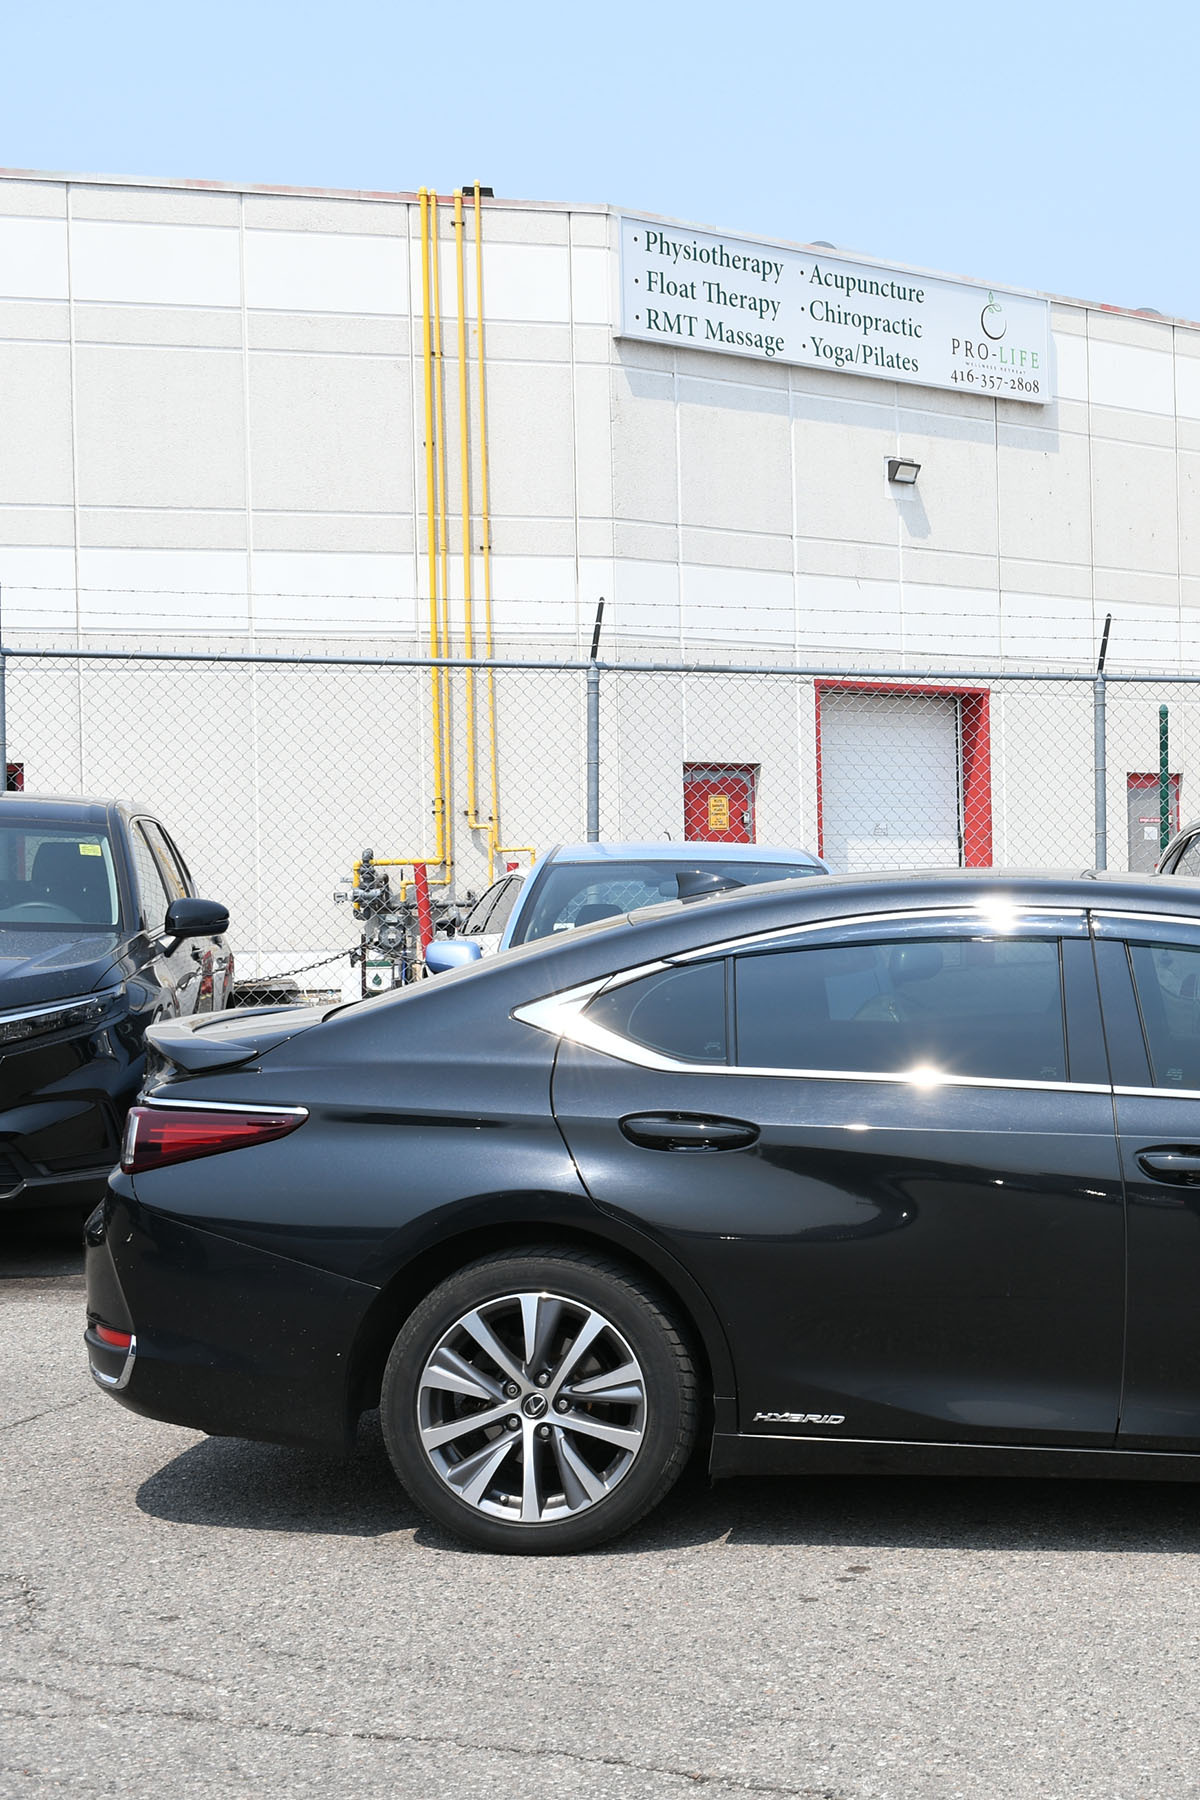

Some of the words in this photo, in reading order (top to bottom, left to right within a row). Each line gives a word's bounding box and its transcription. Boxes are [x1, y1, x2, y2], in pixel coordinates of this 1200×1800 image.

[645, 230, 784, 284] Physiotherapy
[646, 270, 697, 300] Float
[702, 280, 781, 321] Therapy
[809, 263, 925, 304] Acupuncture
[646, 308, 698, 337] RMT
[704, 318, 785, 357] Massage
[809, 299, 923, 339] Chiropractic
[810, 336, 919, 373] Yoga/Pilates
[951, 337, 1040, 369] PRO-LIFE
[950, 369, 1040, 394] 416-357-2808
[752, 1412, 846, 1425] HYBRID
